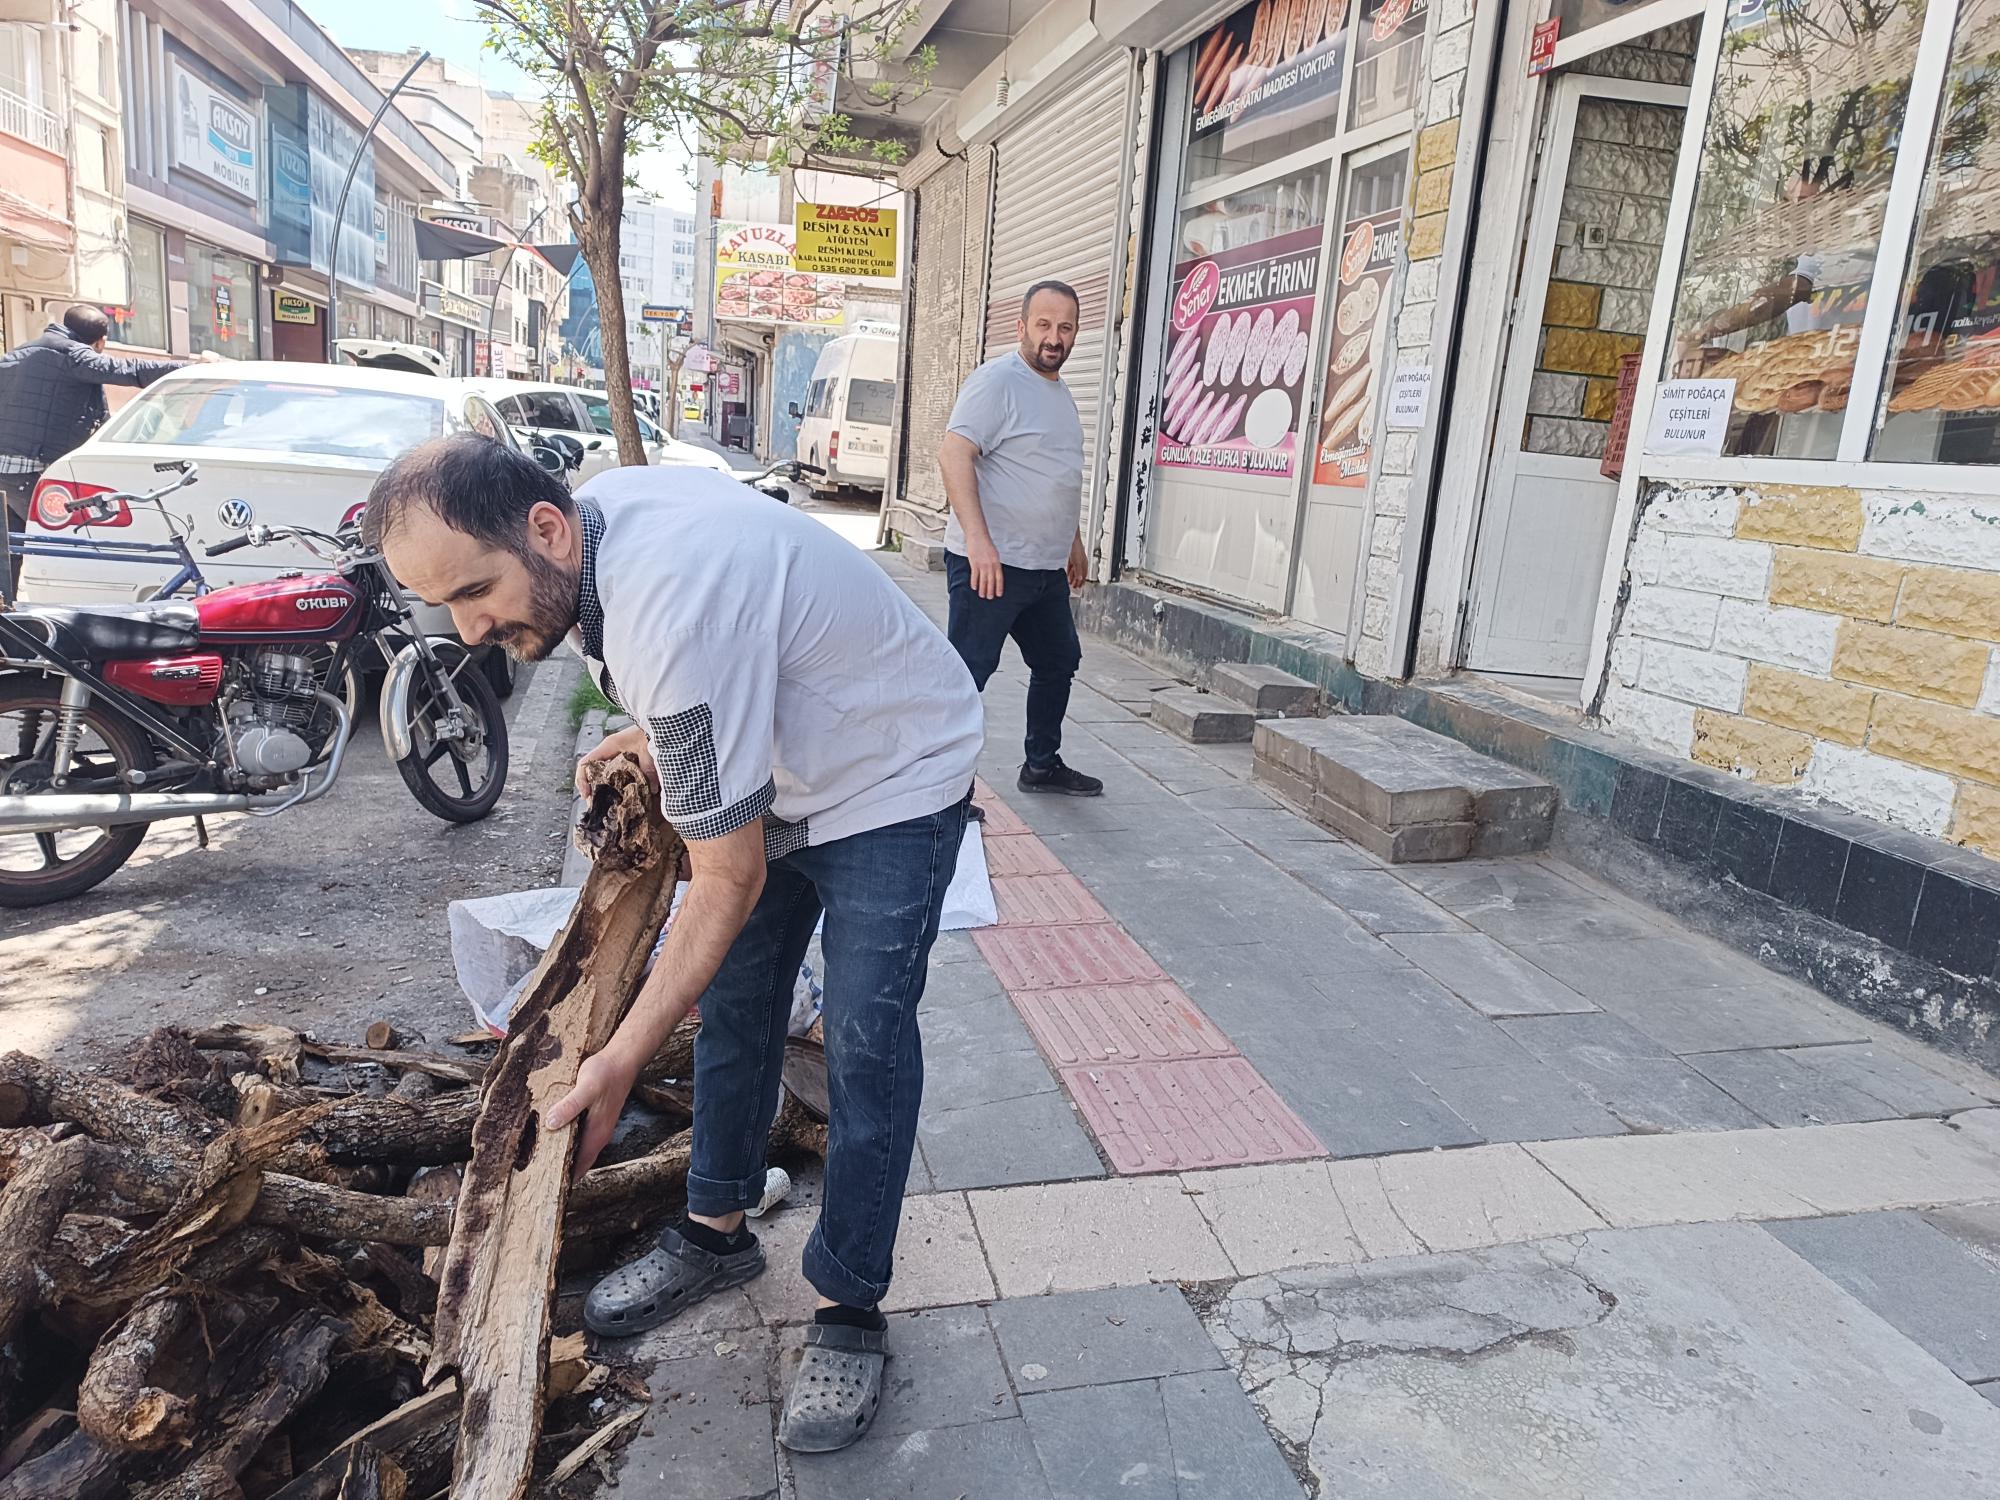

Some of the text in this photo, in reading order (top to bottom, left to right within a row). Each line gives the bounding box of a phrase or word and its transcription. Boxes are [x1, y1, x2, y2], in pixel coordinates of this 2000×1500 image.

[1533, 36, 1546, 56] 21
[1241, 86, 1263, 110] KATKI
[1262, 64, 1299, 100] MADDESİ
[1299, 50, 1336, 81] YOKTUR
[212, 105, 249, 146] AKSOY
[803, 221, 892, 238] RESİM & SANAT
[719, 226, 796, 260] YAVUZLA
[817, 245, 876, 258] RESİM KURSU
[1371, 229, 1399, 263] EKME
[738, 251, 790, 266] KASABI
[820, 265, 837, 273] 535
[839, 266, 857, 274] 620
[858, 267, 870, 275] 76
[871, 268, 881, 276] 61
[1218, 266, 1266, 305] EKMEK
[1266, 256, 1316, 295] FIRINI
[1662, 386, 1726, 402] SİMİT POĞAÇA
[1669, 406, 1711, 422] ÇEŞİTLERİ
[1664, 428, 1706, 440] BULUNUR
[1161, 443, 1192, 463] GÜNLÜK
[1193, 448, 1213, 465] TAZE
[1212, 450, 1239, 468] YUFKA
[1340, 457, 1369, 479] Madde
